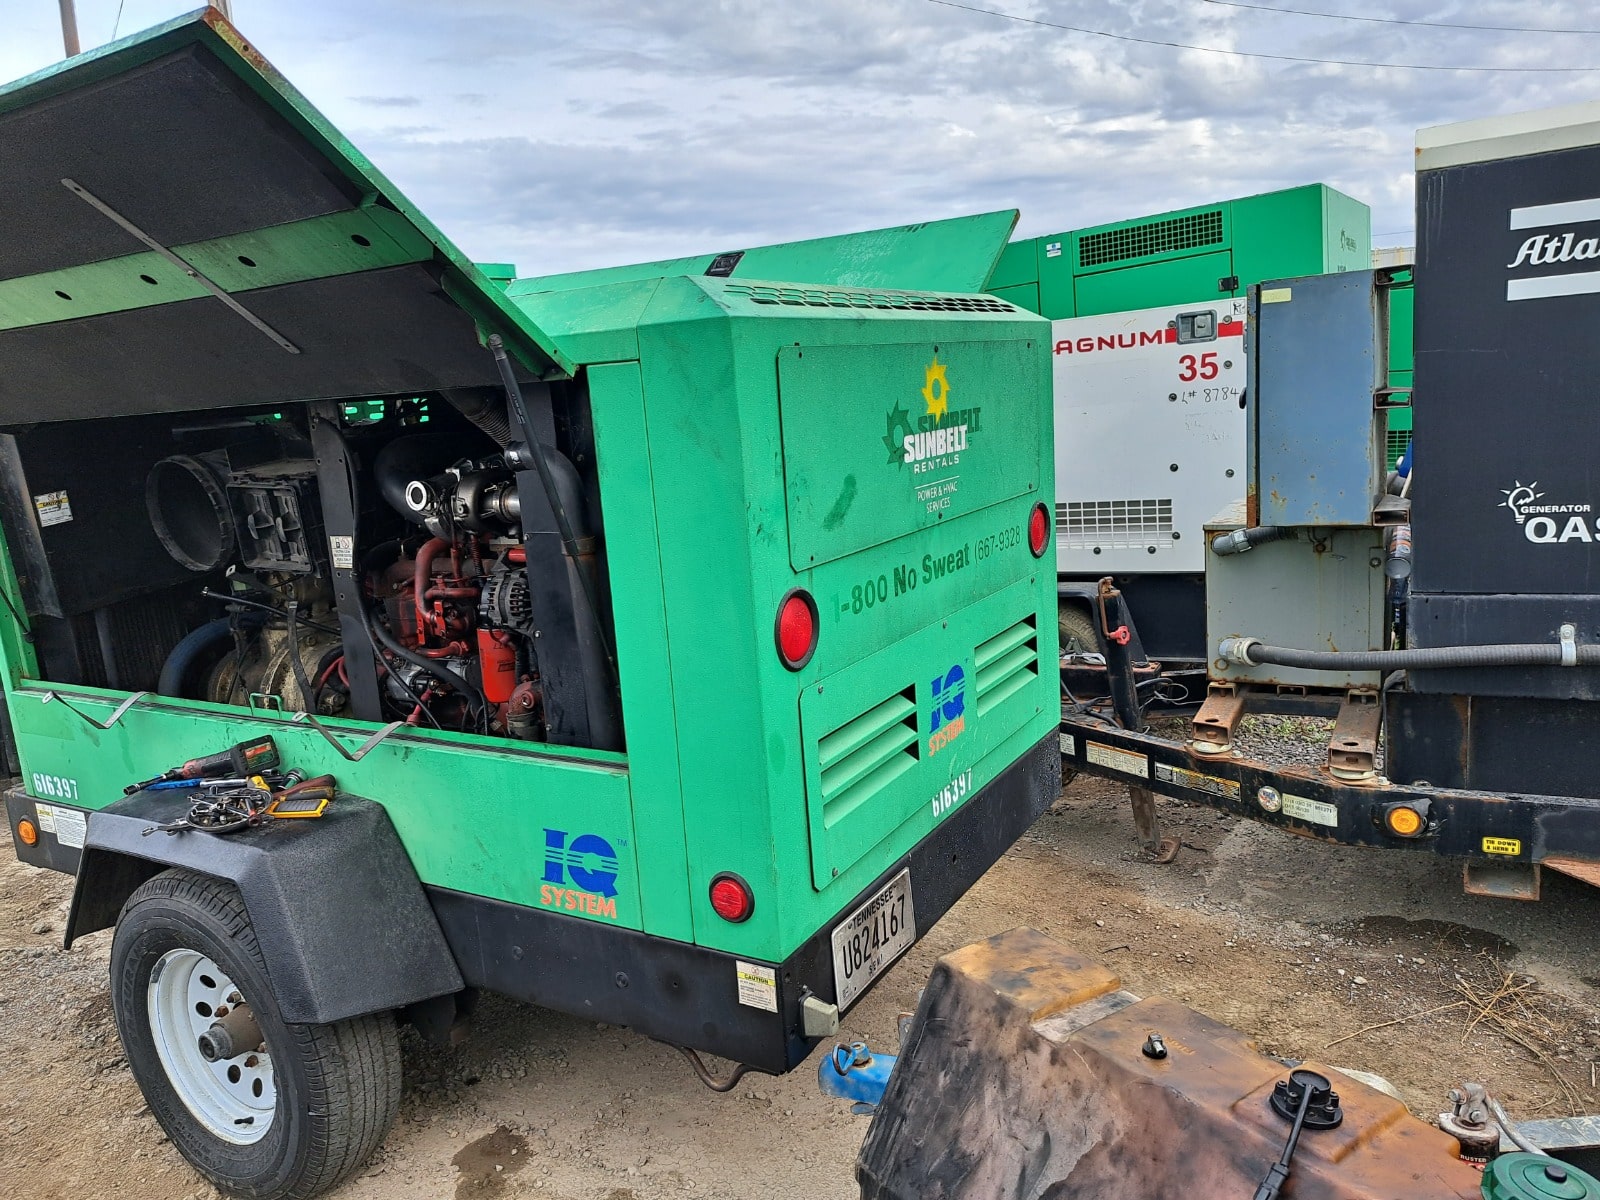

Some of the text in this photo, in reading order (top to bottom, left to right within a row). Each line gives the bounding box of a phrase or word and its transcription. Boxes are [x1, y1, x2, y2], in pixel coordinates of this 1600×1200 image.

[1507, 233, 1600, 268] Atla
[1053, 330, 1163, 355] AGNUM
[1178, 352, 1219, 382] 35
[1203, 386, 1240, 403] 8784
[903, 424, 967, 463] SUNBELT
[914, 454, 960, 474] RENTALS
[917, 487, 937, 502] POWER
[943, 480, 958, 494] HVAC
[926, 497, 951, 513] SERVICES
[1520, 504, 1591, 514] GENERATOR
[1525, 516, 1600, 543] QA
[893, 564, 917, 597] No
[922, 543, 970, 584] Sweat
[929, 664, 966, 734] IQ
[928, 716, 965, 757] SYSTEM
[33, 772, 79, 800] 616397
[932, 768, 973, 818] 616397
[540, 828, 619, 898] IQ
[540, 884, 618, 920] SYSTEM
[853, 889, 894, 930] TENNESSEE
[843, 893, 905, 979] U824167
[744, 973, 769, 985] CAUTION
